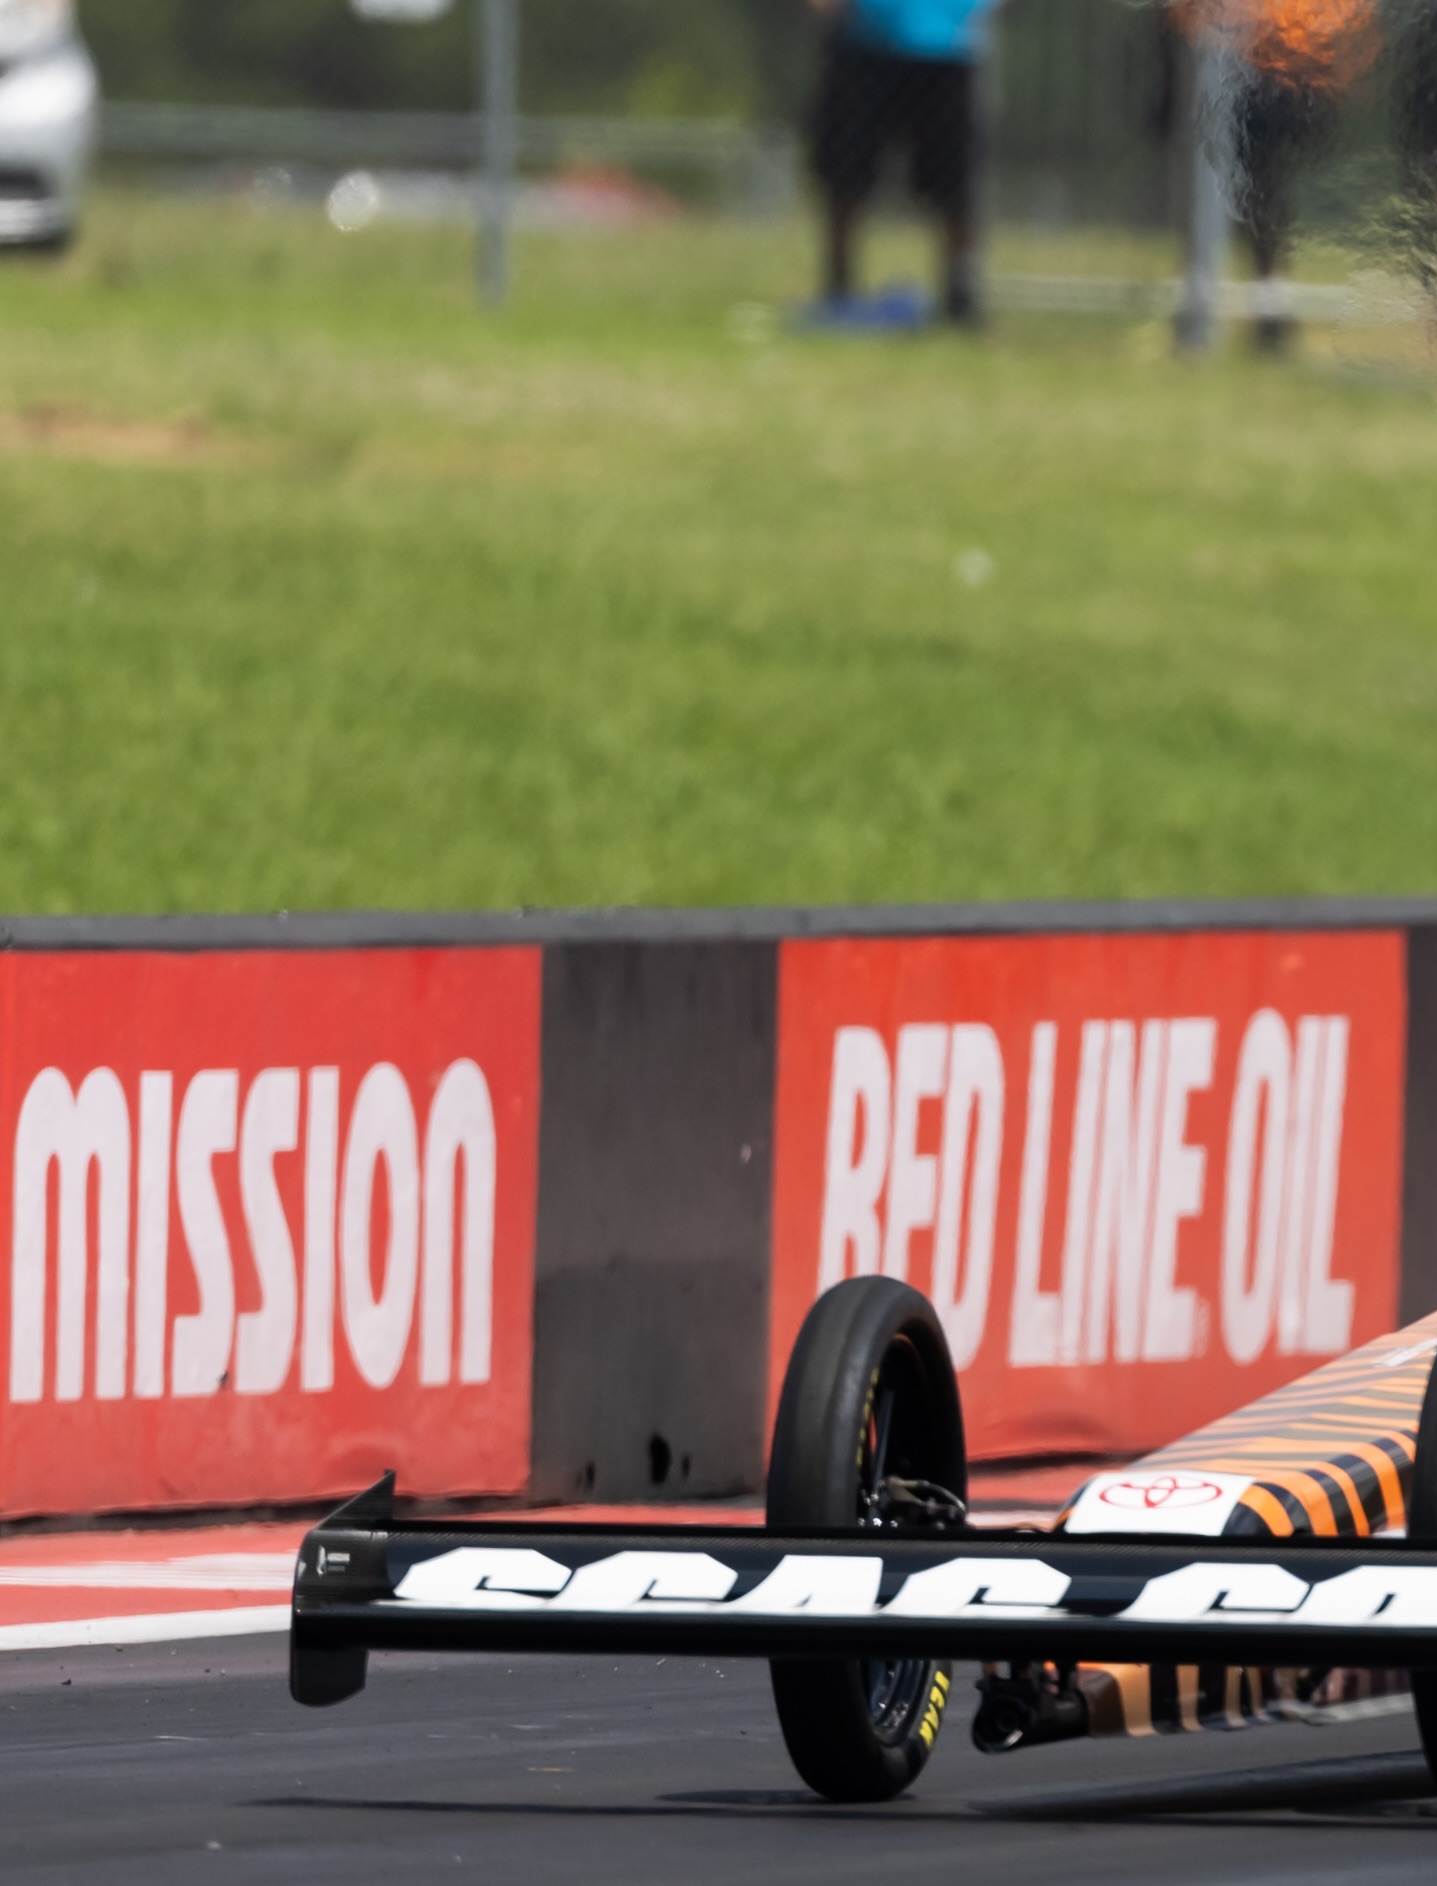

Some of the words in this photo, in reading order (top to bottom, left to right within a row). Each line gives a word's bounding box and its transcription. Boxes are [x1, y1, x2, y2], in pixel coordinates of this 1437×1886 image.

[8, 1056, 498, 1403] MISSION
[816, 1024, 1005, 1373] RED
[1009, 1017, 1218, 1368] LINE
[1220, 1007, 1355, 1367] OIL
